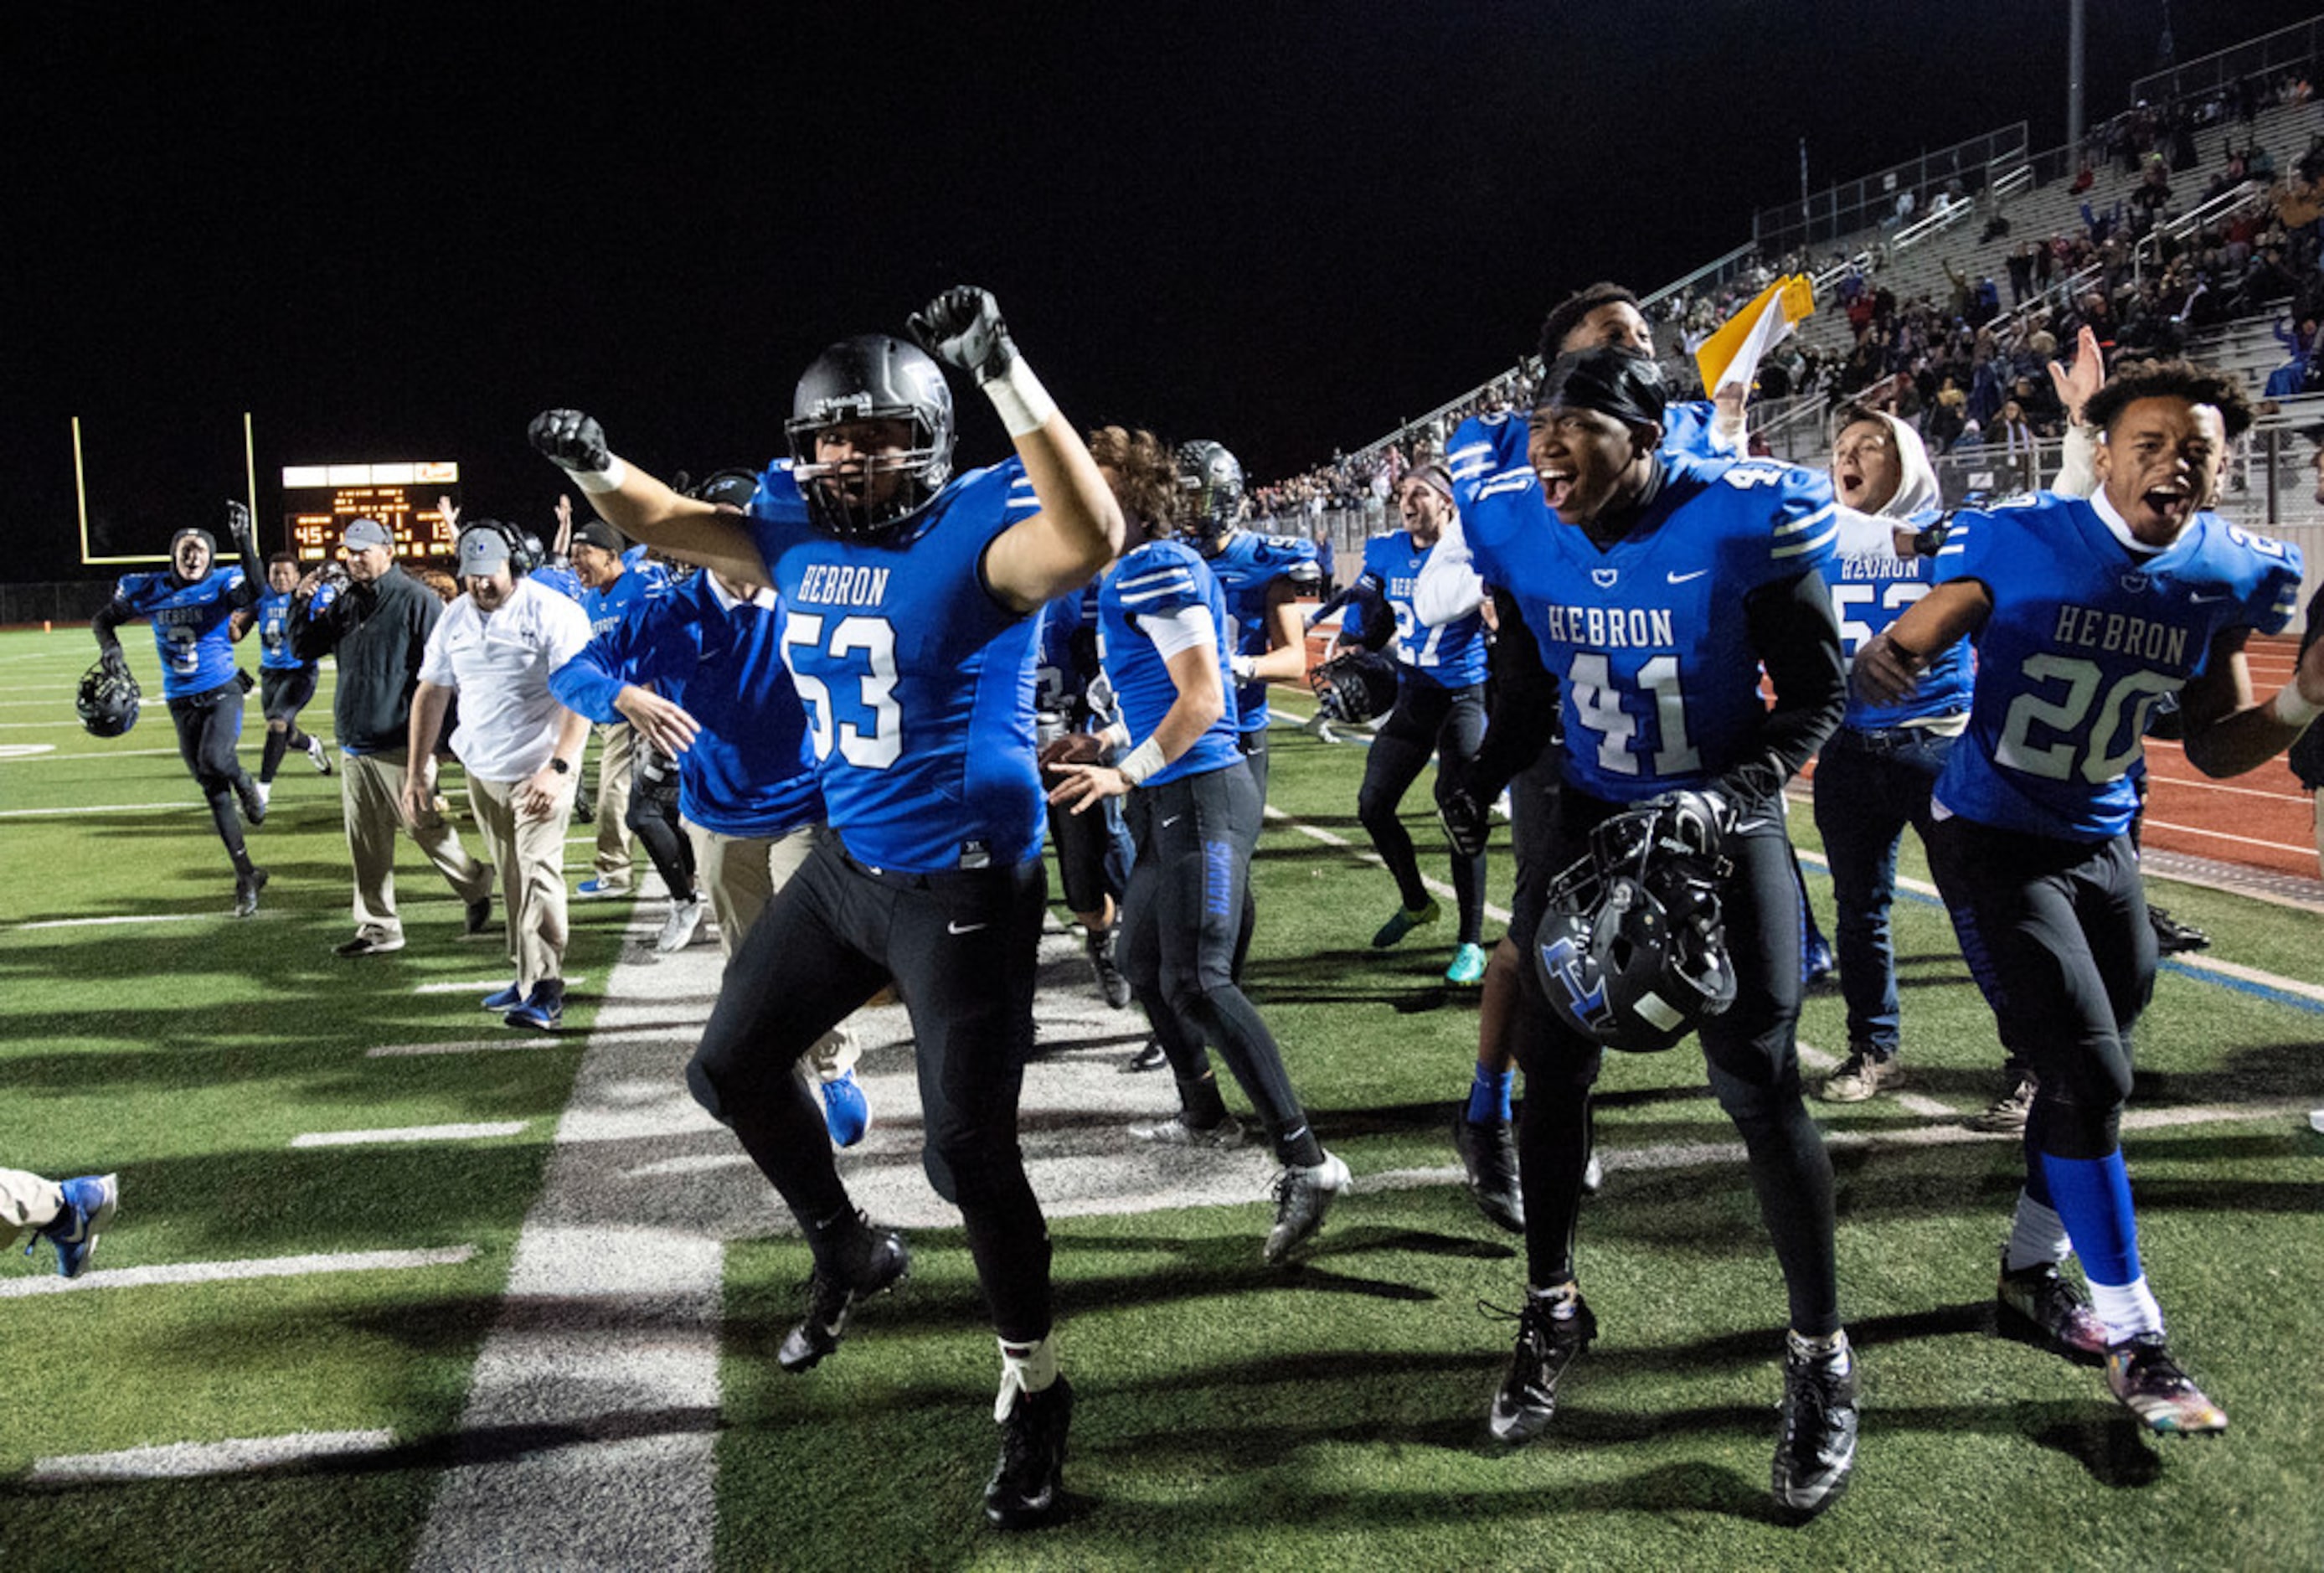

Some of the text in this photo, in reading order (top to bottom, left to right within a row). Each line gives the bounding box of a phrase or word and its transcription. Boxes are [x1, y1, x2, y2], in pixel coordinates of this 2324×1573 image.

[294, 526, 323, 544] 45
[431, 521, 450, 540] 13
[798, 565, 889, 606] HEBRON
[157, 606, 204, 626] HEBRON
[262, 619, 283, 657] 4
[1548, 605, 1674, 647] HEBRON
[2054, 604, 2188, 667] HEBRON
[167, 626, 200, 674] 3
[780, 612, 903, 771] 53
[1568, 652, 1702, 776] 41
[1993, 652, 2187, 786] 20
[1205, 840, 1233, 916] HAWKS
